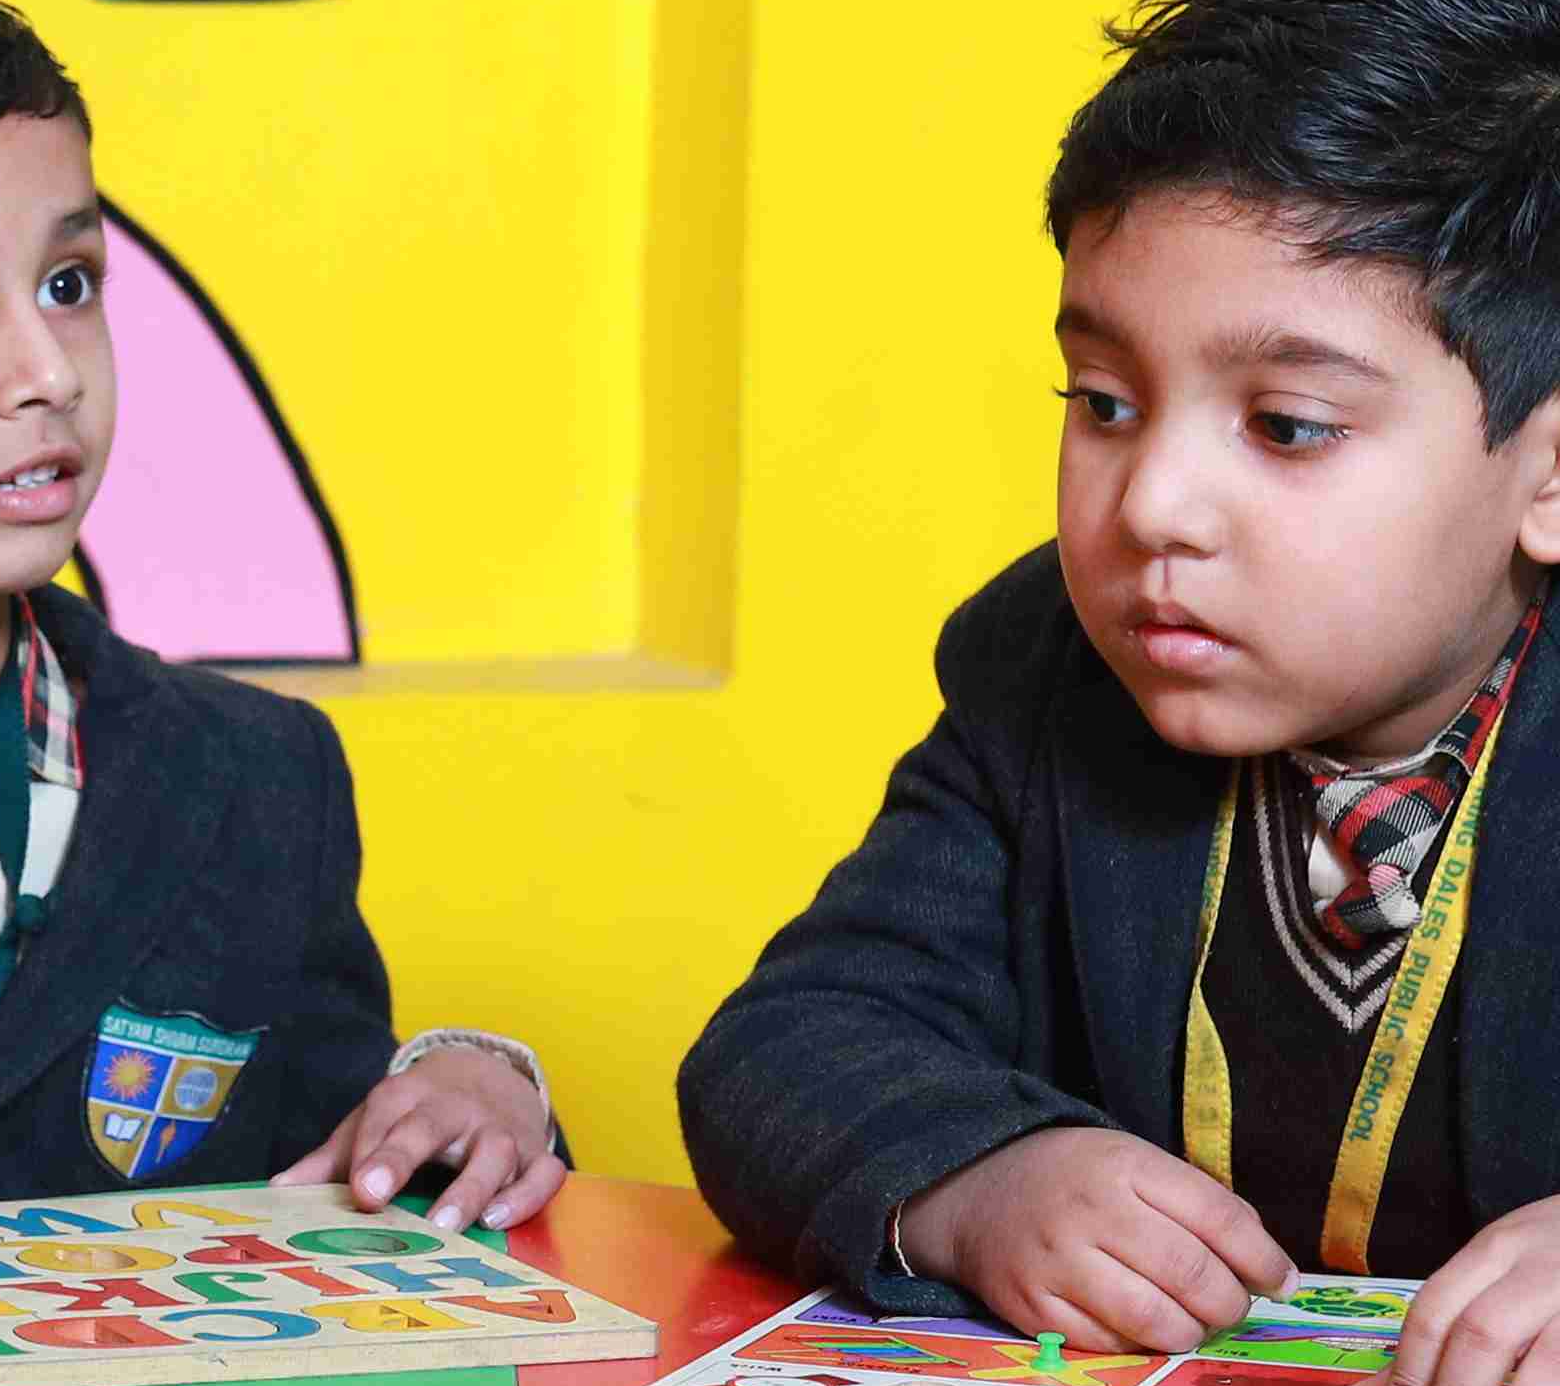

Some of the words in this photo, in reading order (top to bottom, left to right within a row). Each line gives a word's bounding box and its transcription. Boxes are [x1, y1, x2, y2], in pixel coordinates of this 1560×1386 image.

[1421, 858, 1467, 941] DALES
[1386, 949, 1431, 1041] PUBLIC
[1349, 1051, 1394, 1142] SCHOOL
[131, 1199, 273, 1230] V
[184, 1233, 315, 1265] P
[287, 1227, 445, 1258] O
[173, 1271, 273, 1305] J
[265, 1265, 380, 1297] I
[346, 1256, 542, 1292] H
[299, 1299, 484, 1334] B
[438, 1289, 576, 1324] A
[15, 1314, 200, 1350] D
[159, 1308, 322, 1343] C
